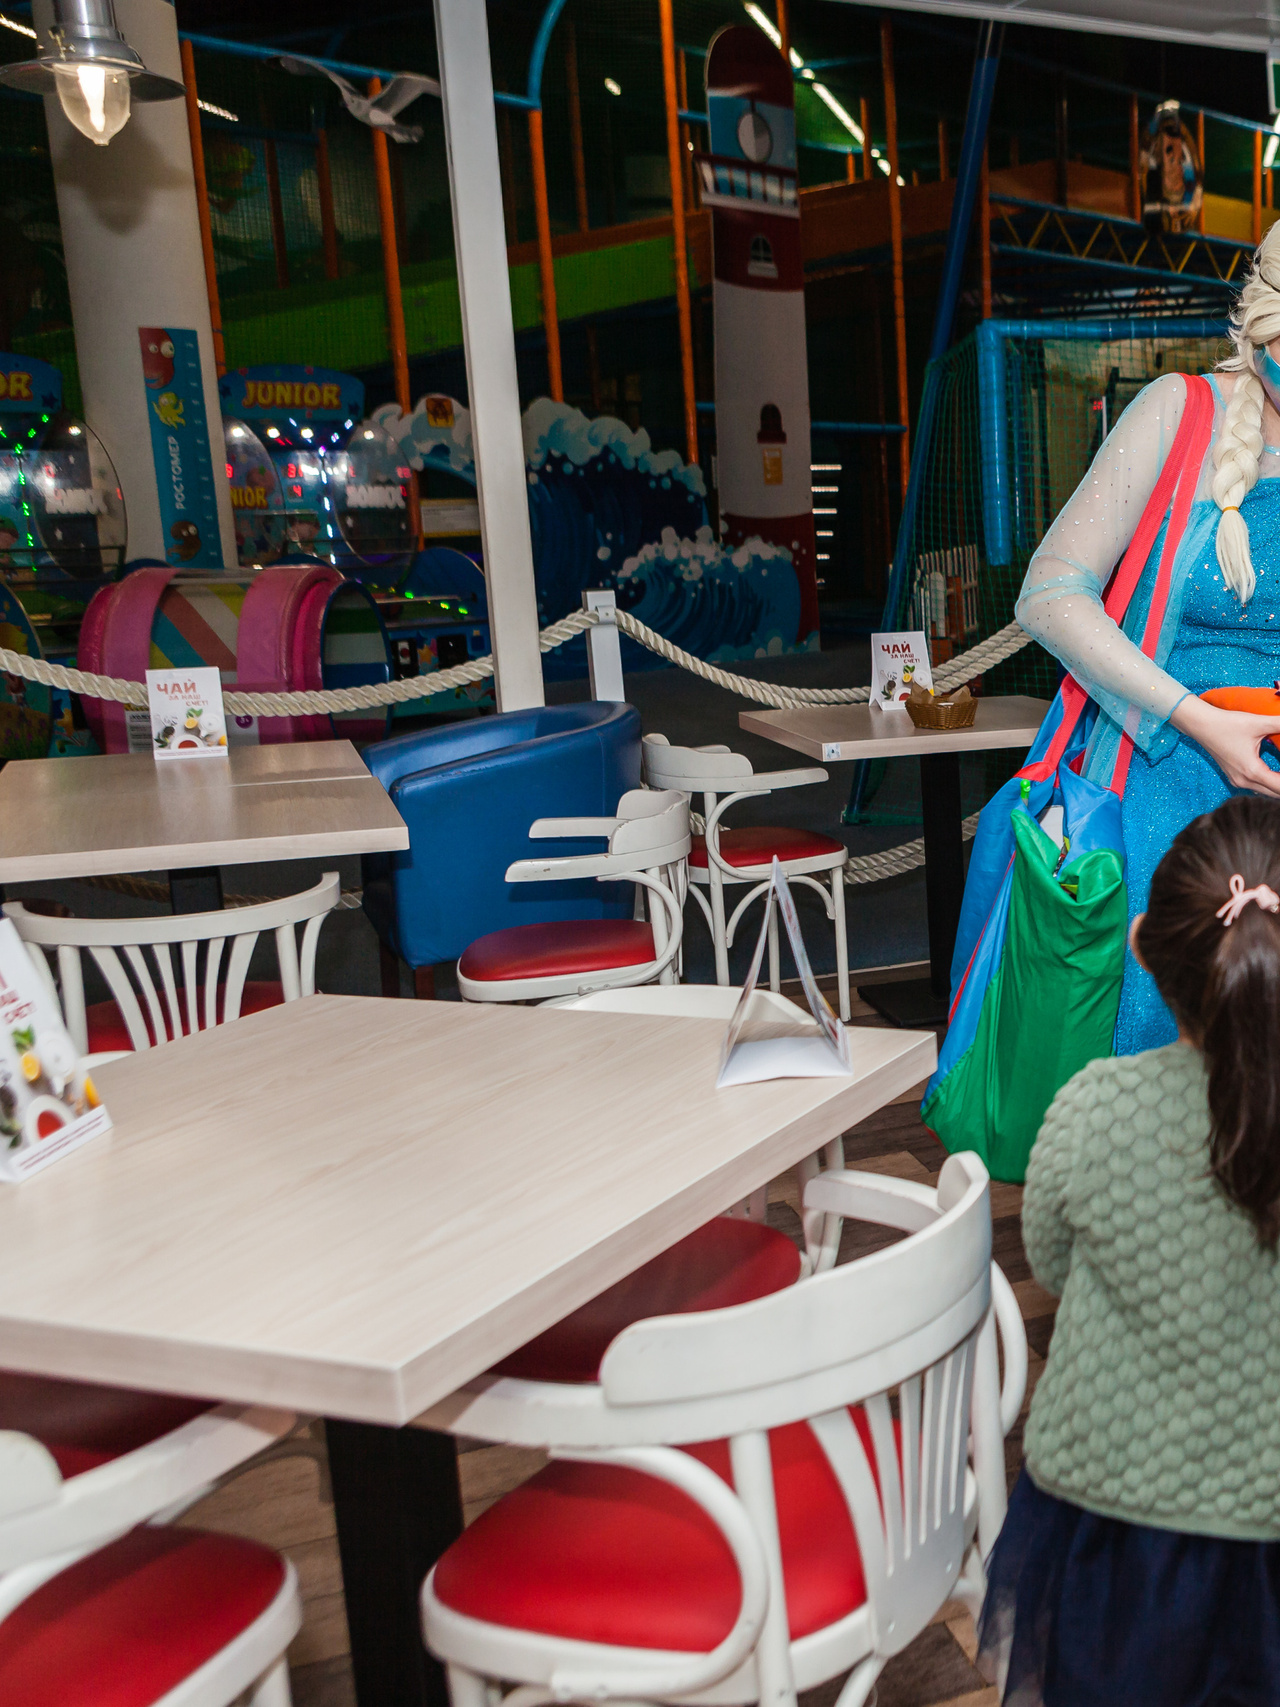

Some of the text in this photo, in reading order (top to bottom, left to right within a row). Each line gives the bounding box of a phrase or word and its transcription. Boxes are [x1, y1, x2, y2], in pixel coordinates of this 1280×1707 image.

[242, 380, 342, 409] JUNIOR
[167, 435, 186, 509] РОСТОМЕР
[881, 641, 911, 654] ЧАЙ
[156, 679, 197, 694] ЧАЙ
